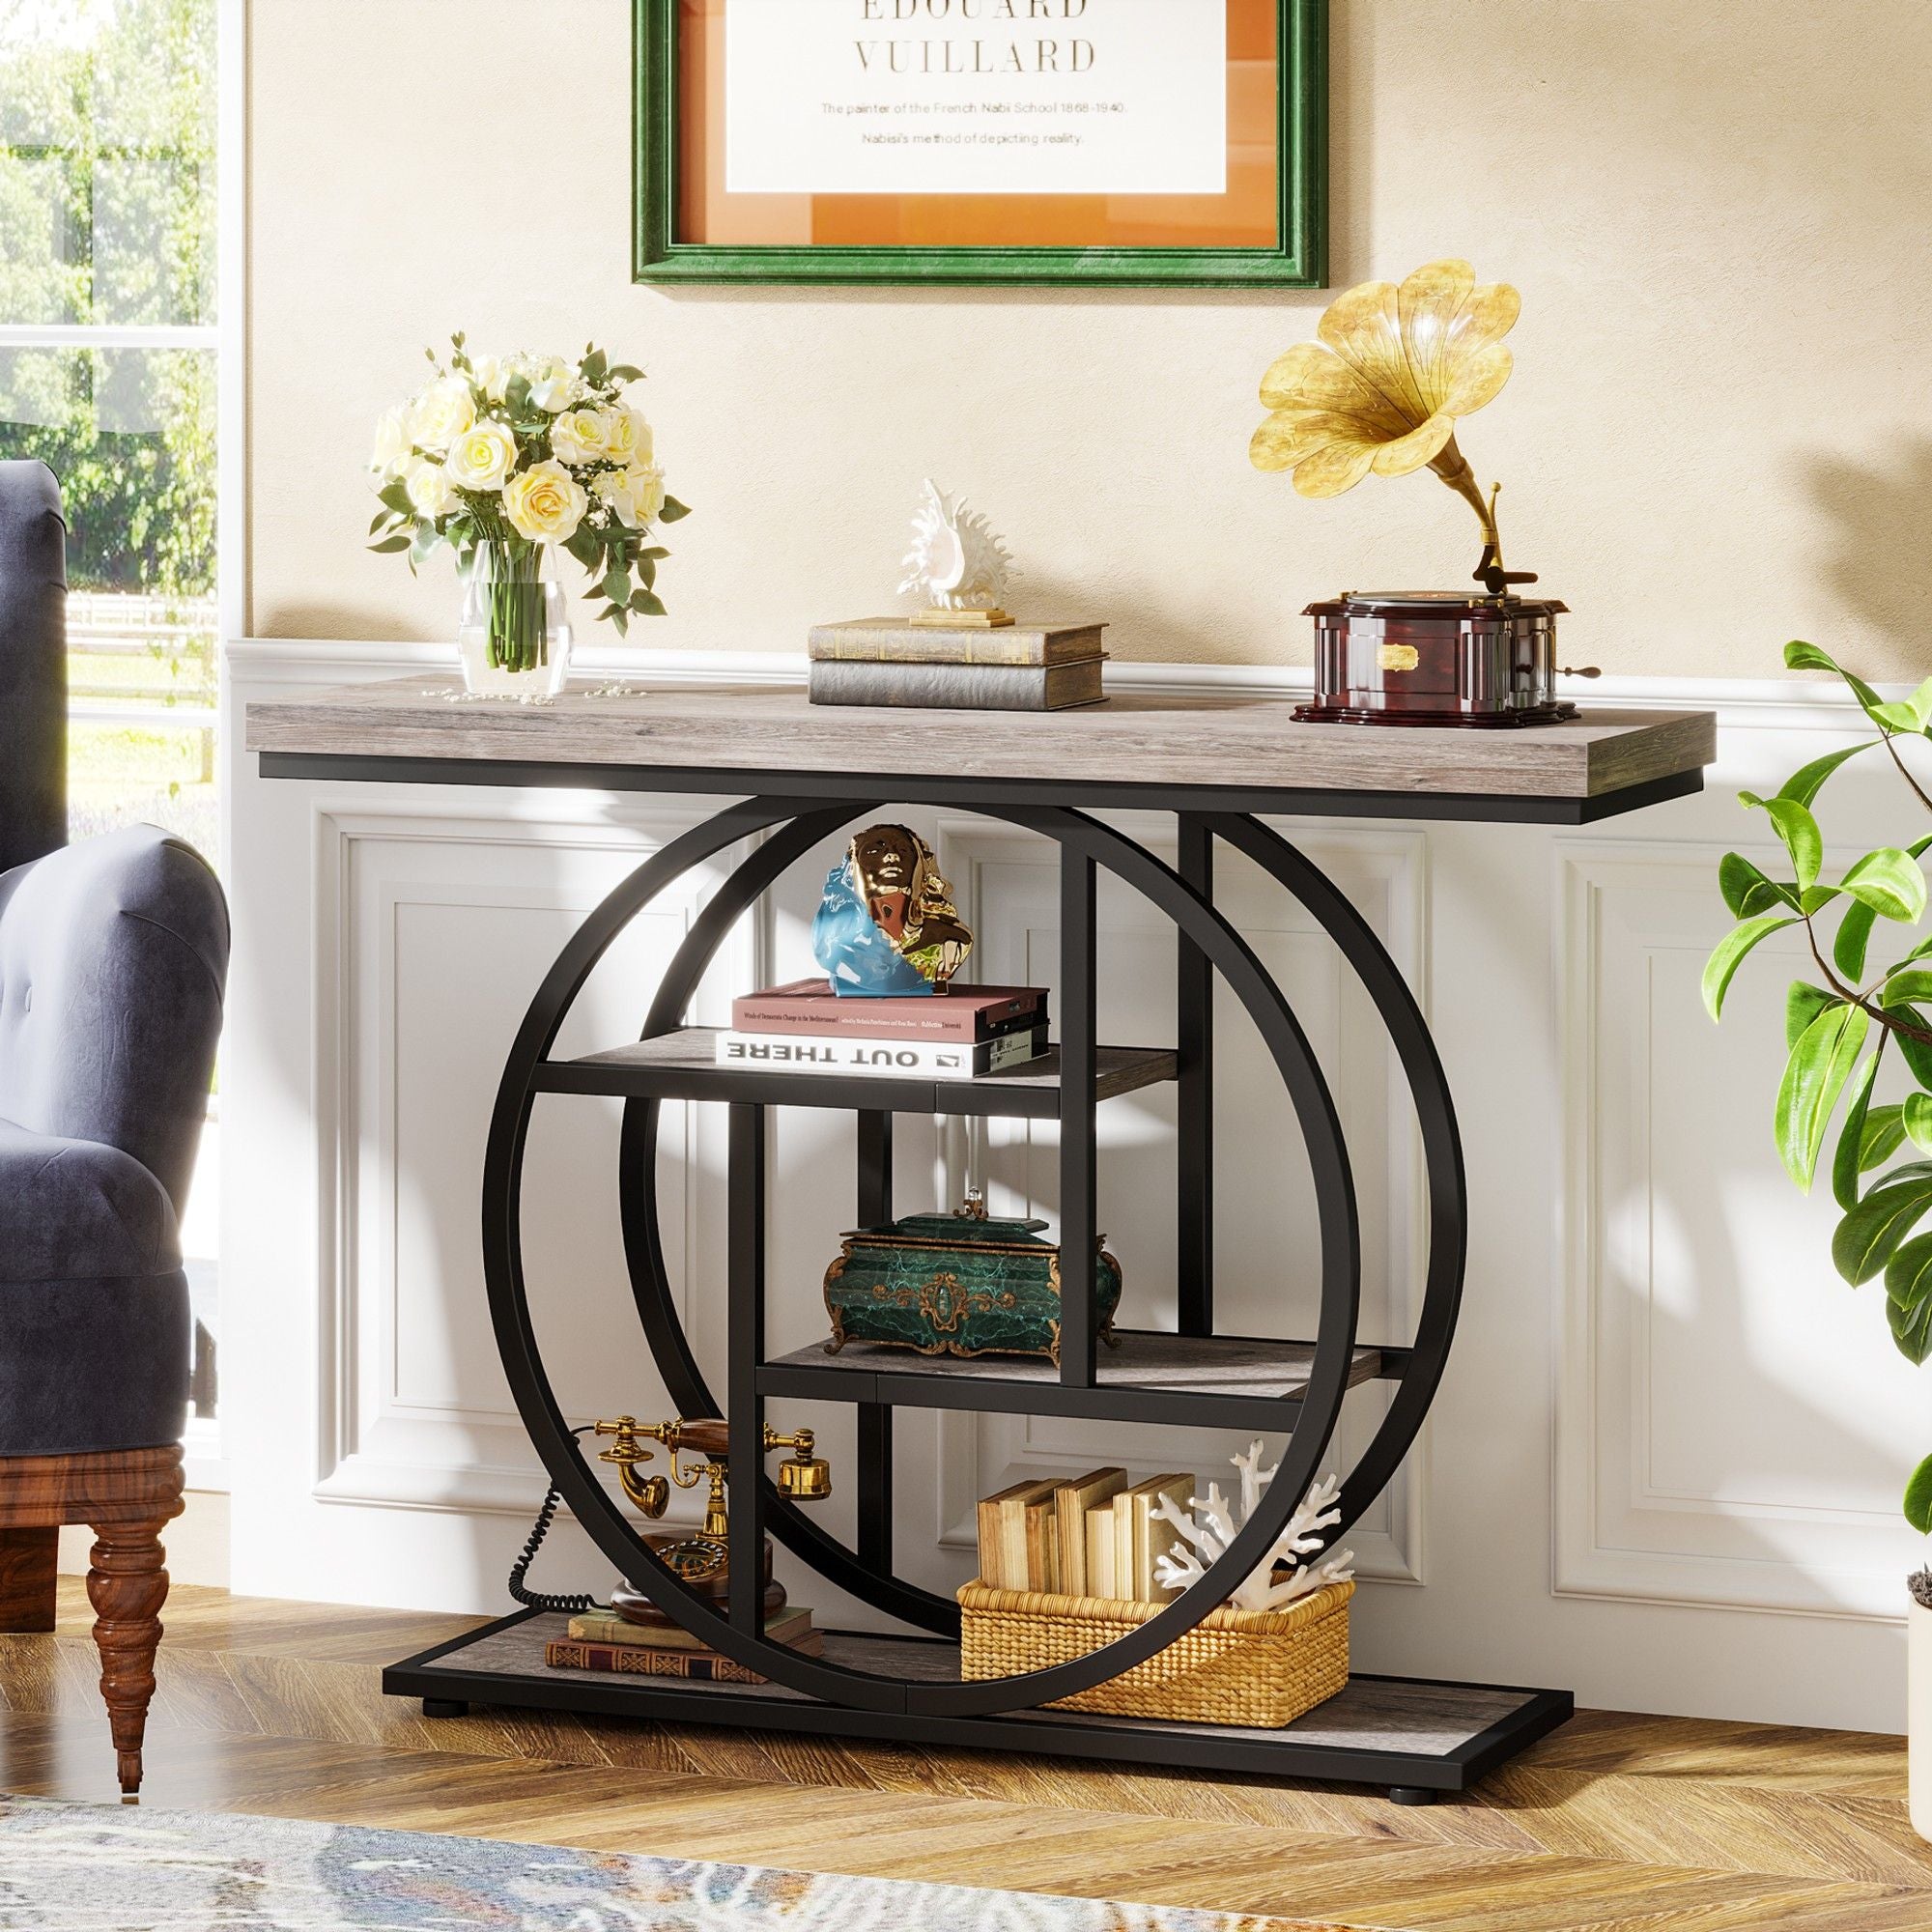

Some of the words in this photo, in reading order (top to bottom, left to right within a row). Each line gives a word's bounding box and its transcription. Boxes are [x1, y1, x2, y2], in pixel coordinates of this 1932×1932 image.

[860, 0, 1087, 19] EDOUARD
[854, 40, 1094, 73] VUILLARD
[822, 102, 843, 114] The
[846, 102, 890, 117] painter
[894, 102, 906, 114] of
[908, 102, 930, 114] the
[933, 102, 977, 114] French
[981, 102, 1010, 114] Nabi
[1014, 102, 1058, 114] School
[912, 132, 962, 144] method
[964, 132, 978, 144] of
[979, 132, 1038, 146] depicting
[1042, 132, 1085, 146] reality.
[726, 1041, 838, 1064] THERE
[850, 1048, 920, 1067] OUT
